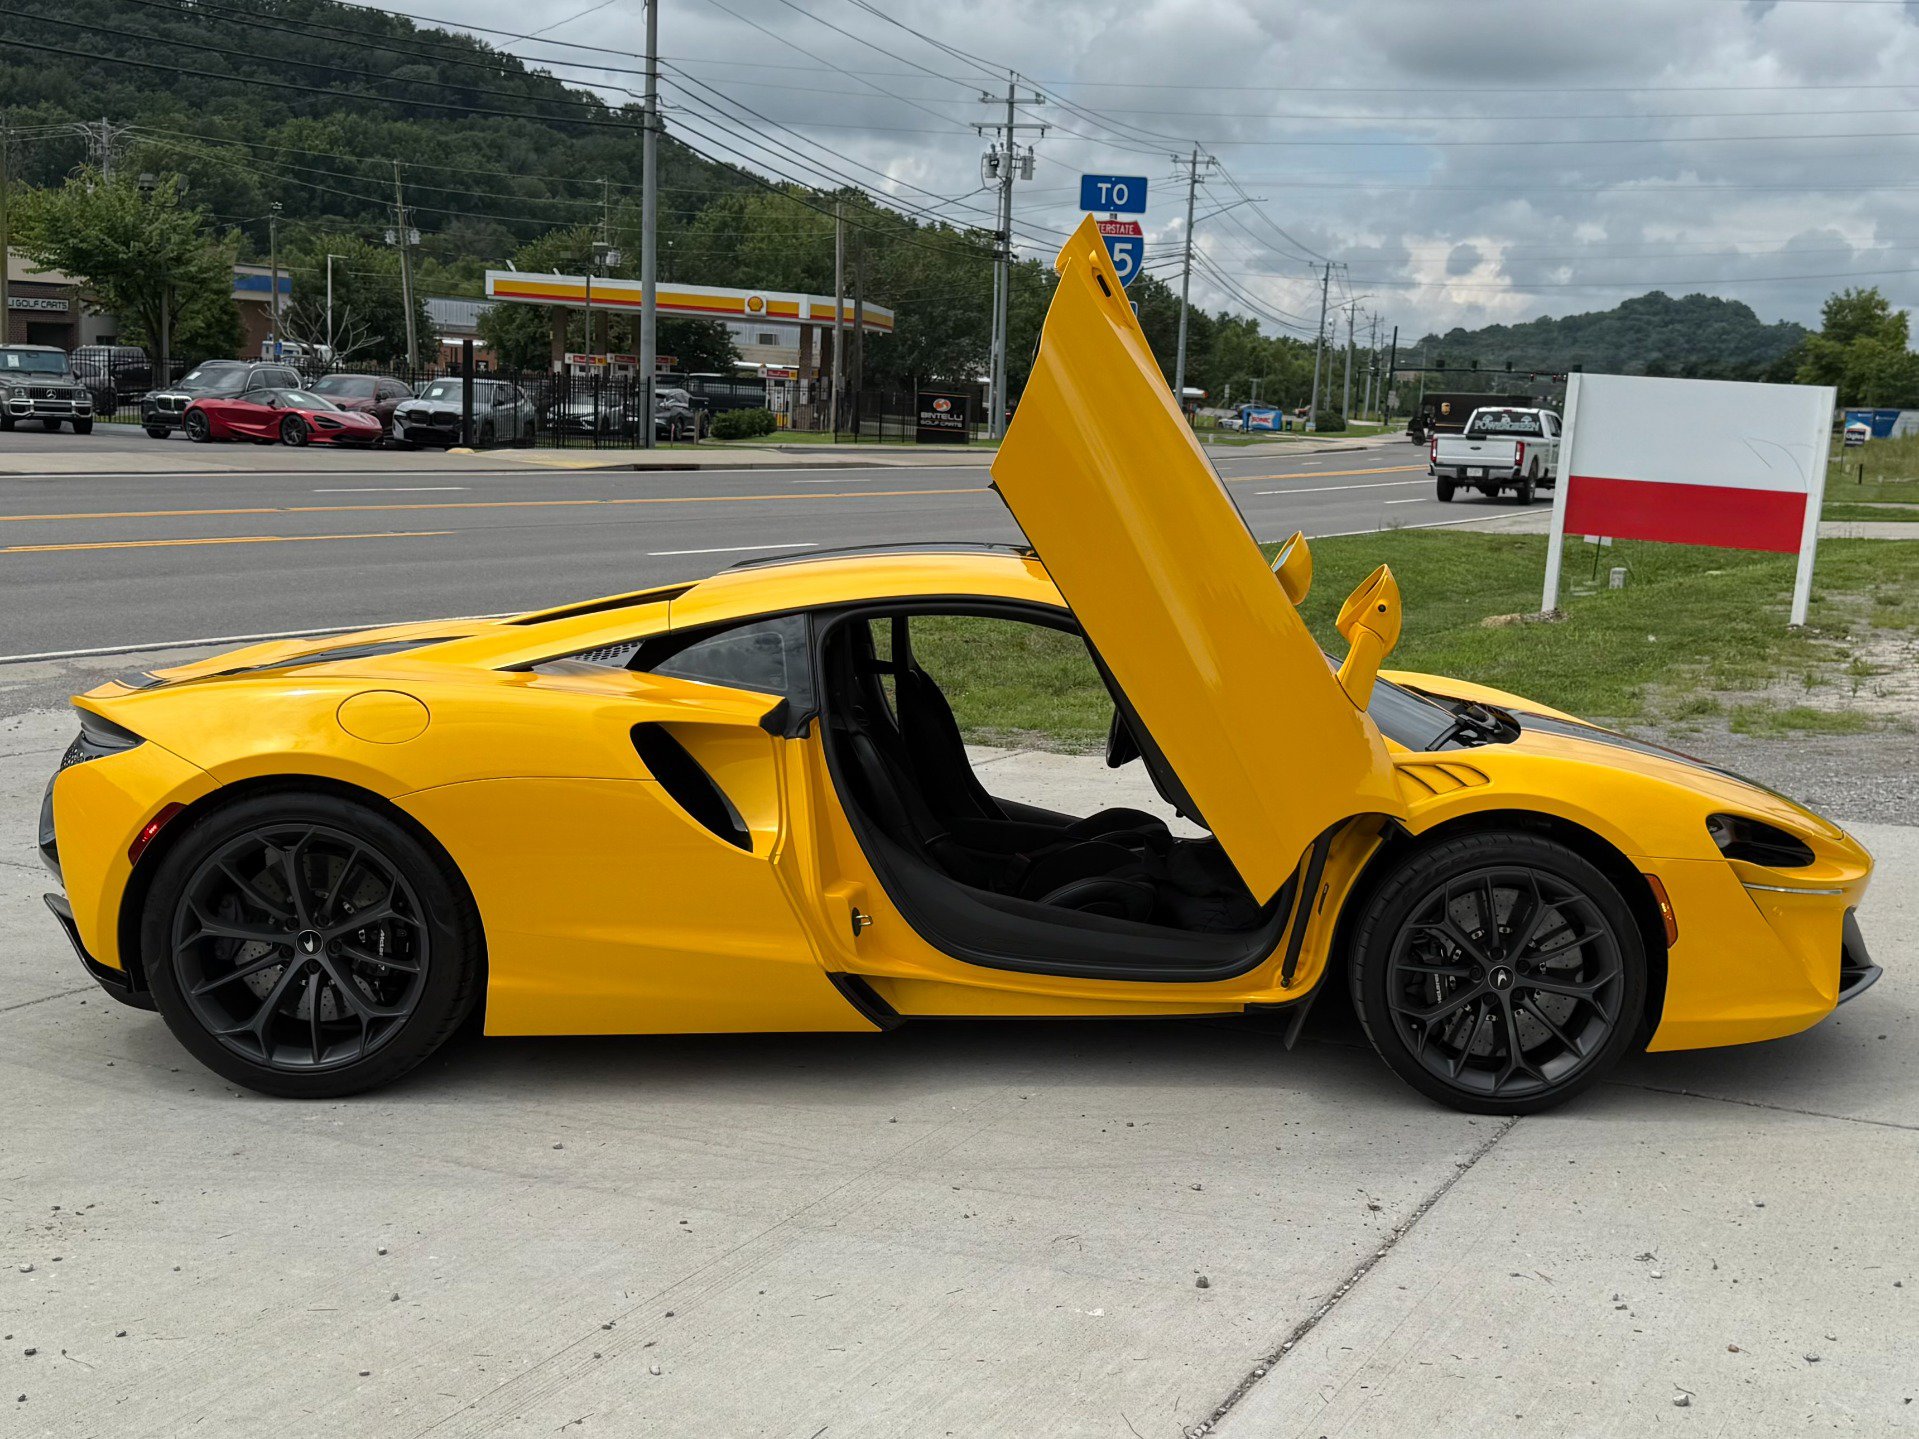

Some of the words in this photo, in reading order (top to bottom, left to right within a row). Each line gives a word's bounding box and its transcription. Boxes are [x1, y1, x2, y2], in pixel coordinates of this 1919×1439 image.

[1097, 183, 1129, 205] TO
[1098, 223, 1135, 235] TERSTATE
[1113, 243, 1133, 277] 5
[15, 300, 39, 308] GOLF
[40, 301, 68, 310] CARTS
[920, 411, 963, 421] BINTELLI
